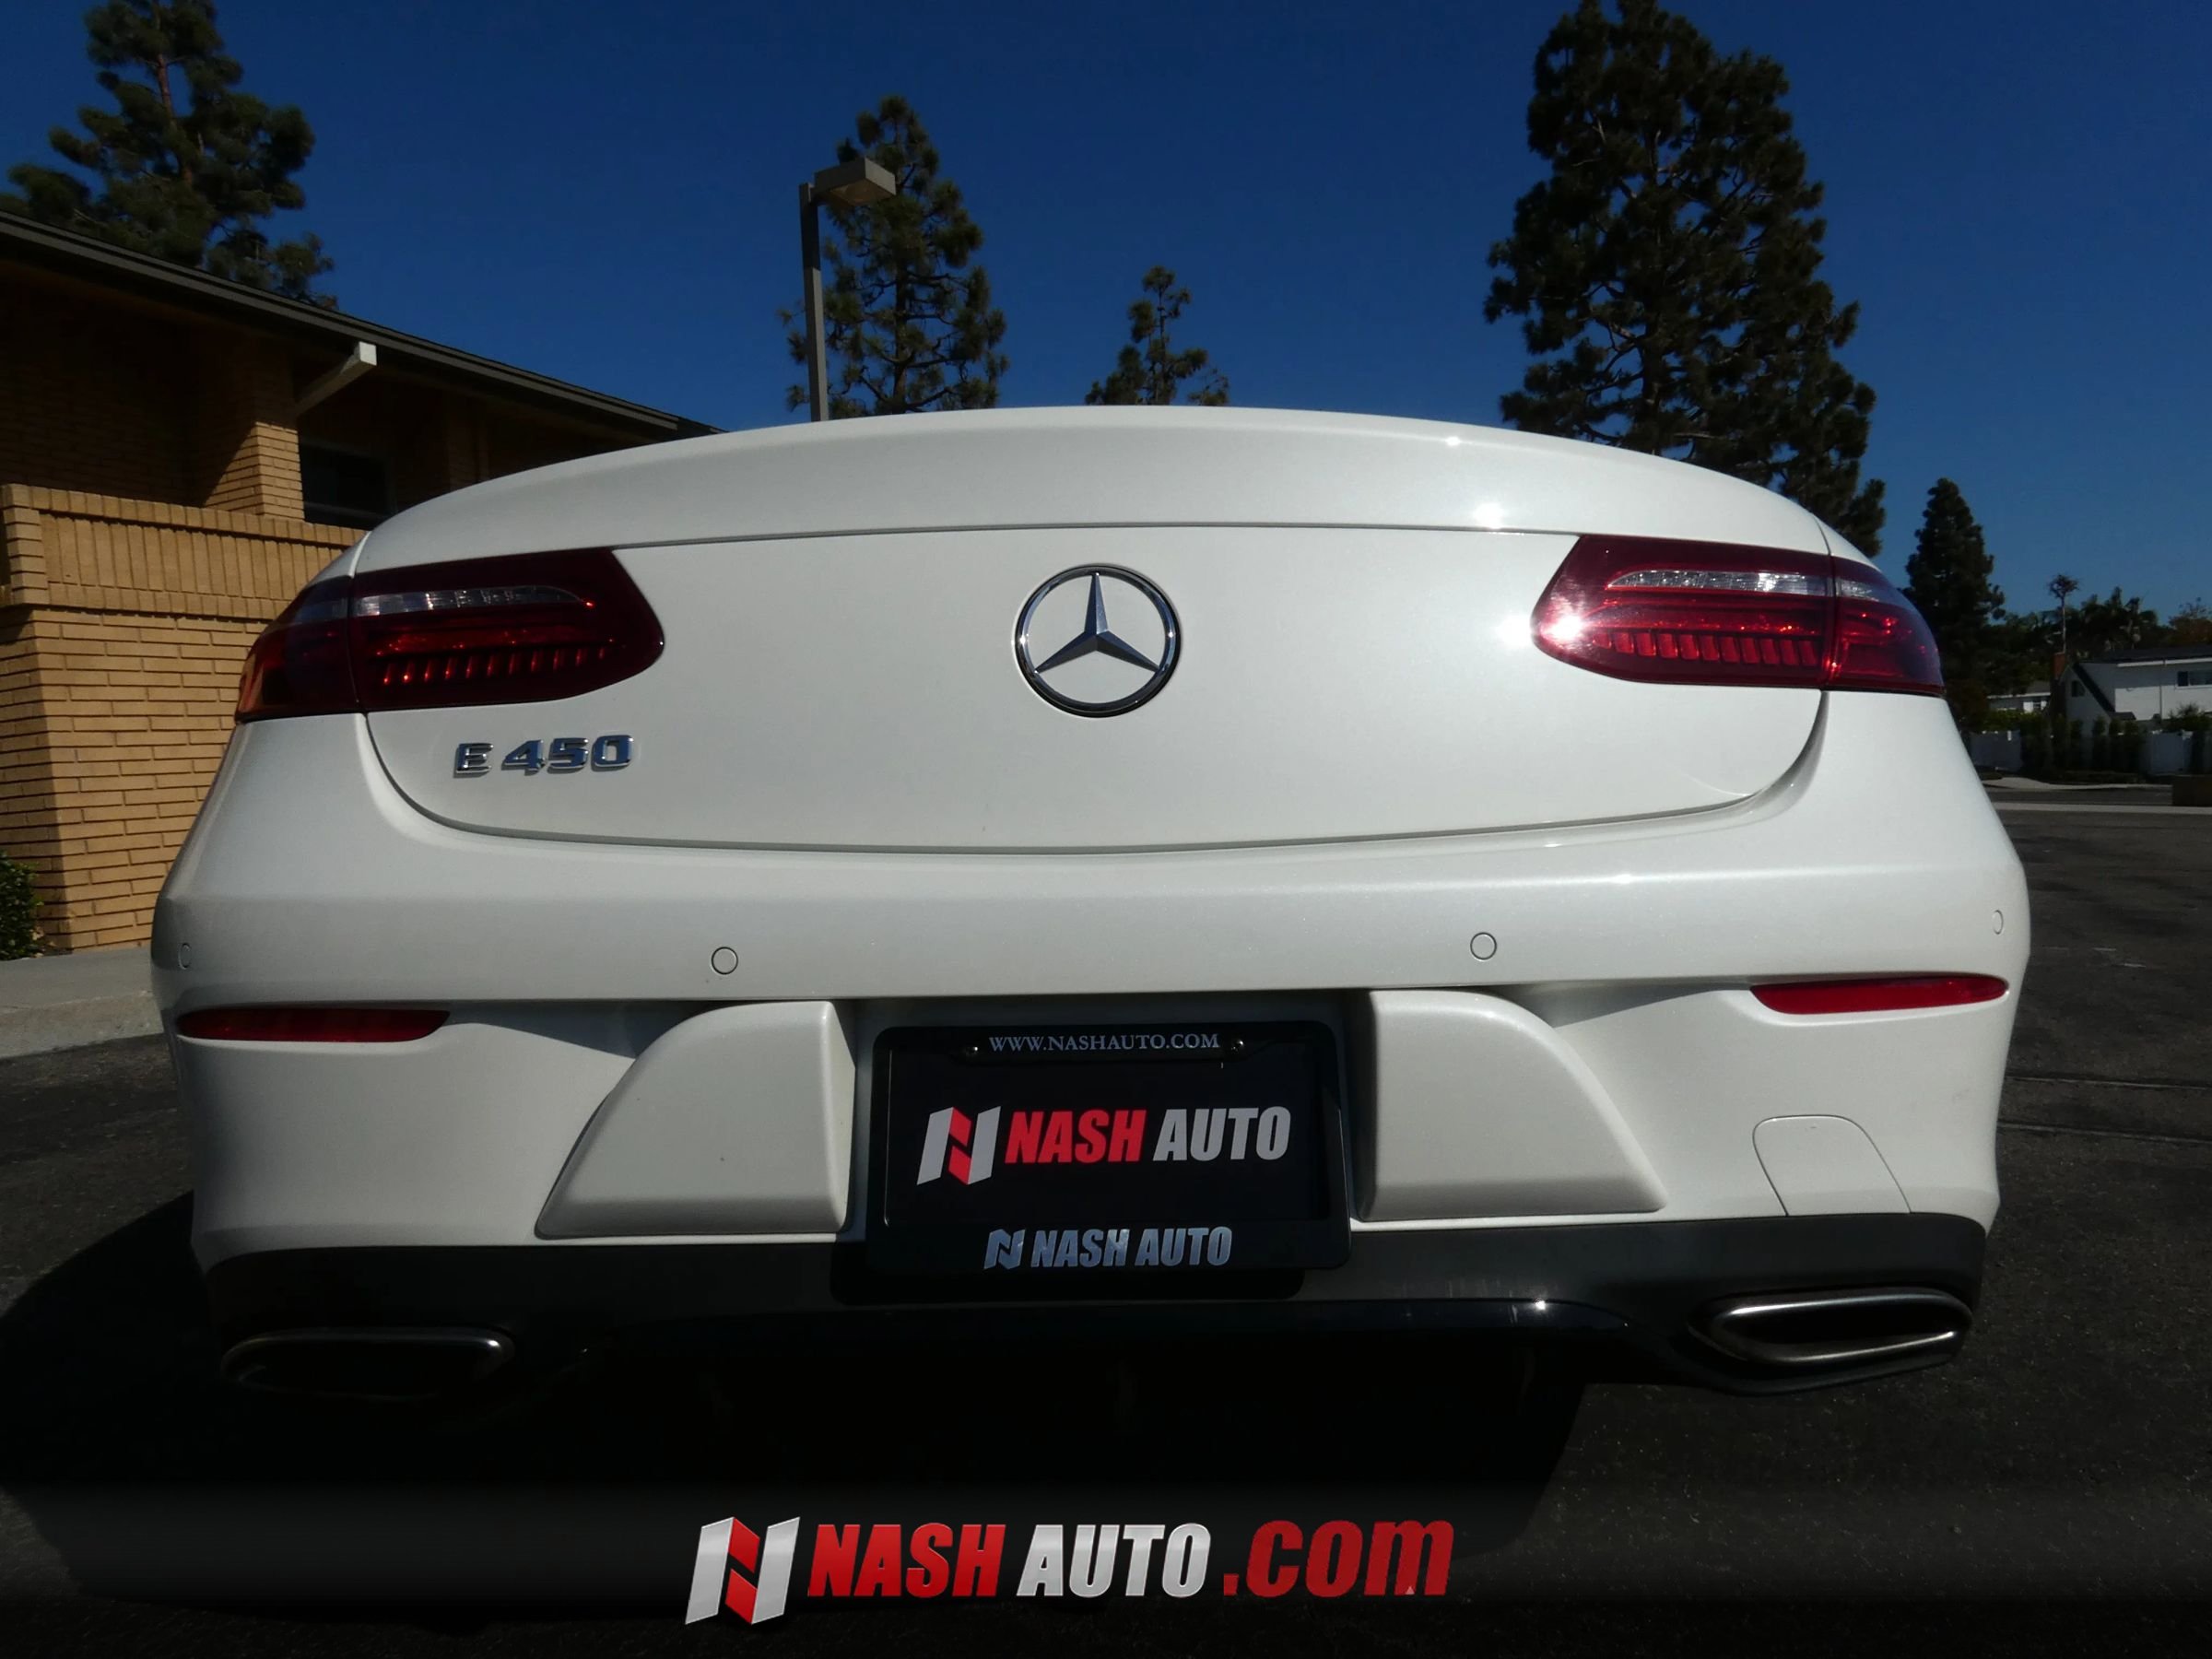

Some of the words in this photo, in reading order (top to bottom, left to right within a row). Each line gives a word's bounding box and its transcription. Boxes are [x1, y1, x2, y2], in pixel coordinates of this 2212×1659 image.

[456, 742, 494, 773] E
[503, 735, 634, 771] 450
[989, 1033, 1219, 1052] WWW.NASHAUTO.COM
[1004, 1109, 1147, 1164] NASH
[1152, 1106, 1291, 1161] AUTO
[1030, 1228, 1131, 1267] NASH
[1135, 1226, 1233, 1266] AUTO
